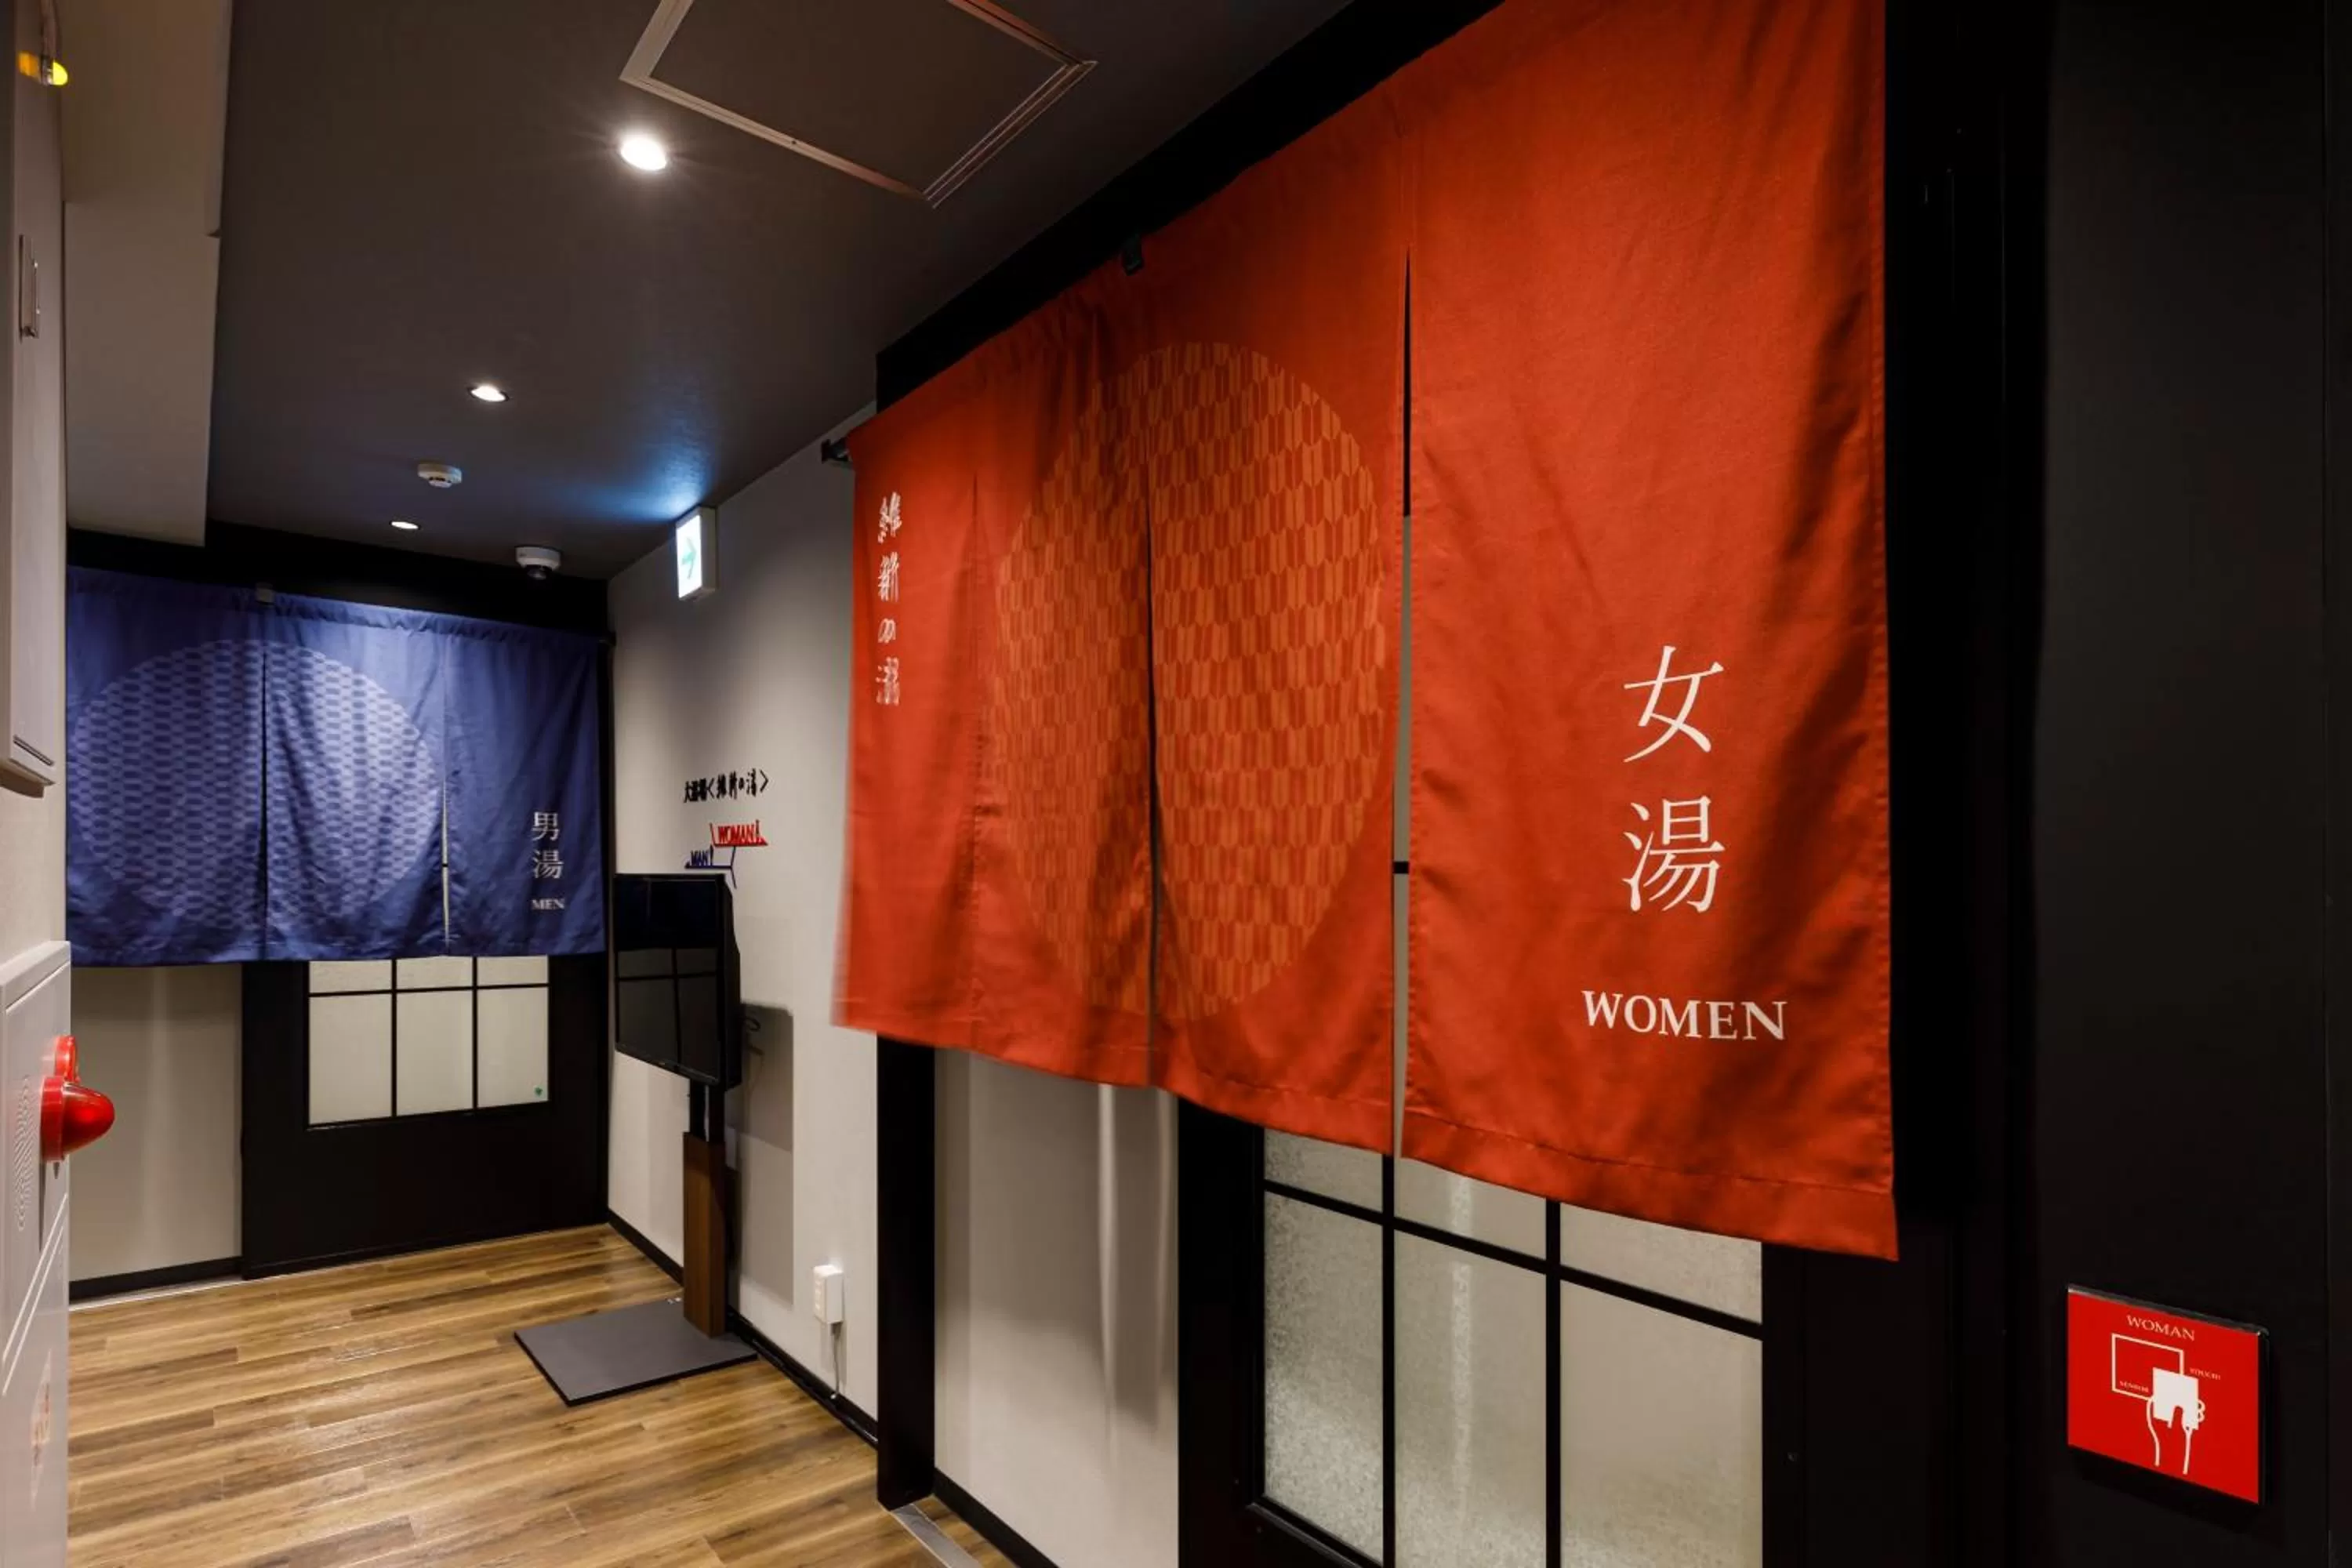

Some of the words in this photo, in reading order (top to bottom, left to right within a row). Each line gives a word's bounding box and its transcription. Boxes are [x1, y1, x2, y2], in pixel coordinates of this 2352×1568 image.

[1621, 644, 1725, 913] 女湯
[531, 811, 564, 880] 男湯
[532, 898, 565, 910] MEN
[1581, 990, 1788, 1041] WOMEN
[2126, 1314, 2195, 1341] WOMAN
